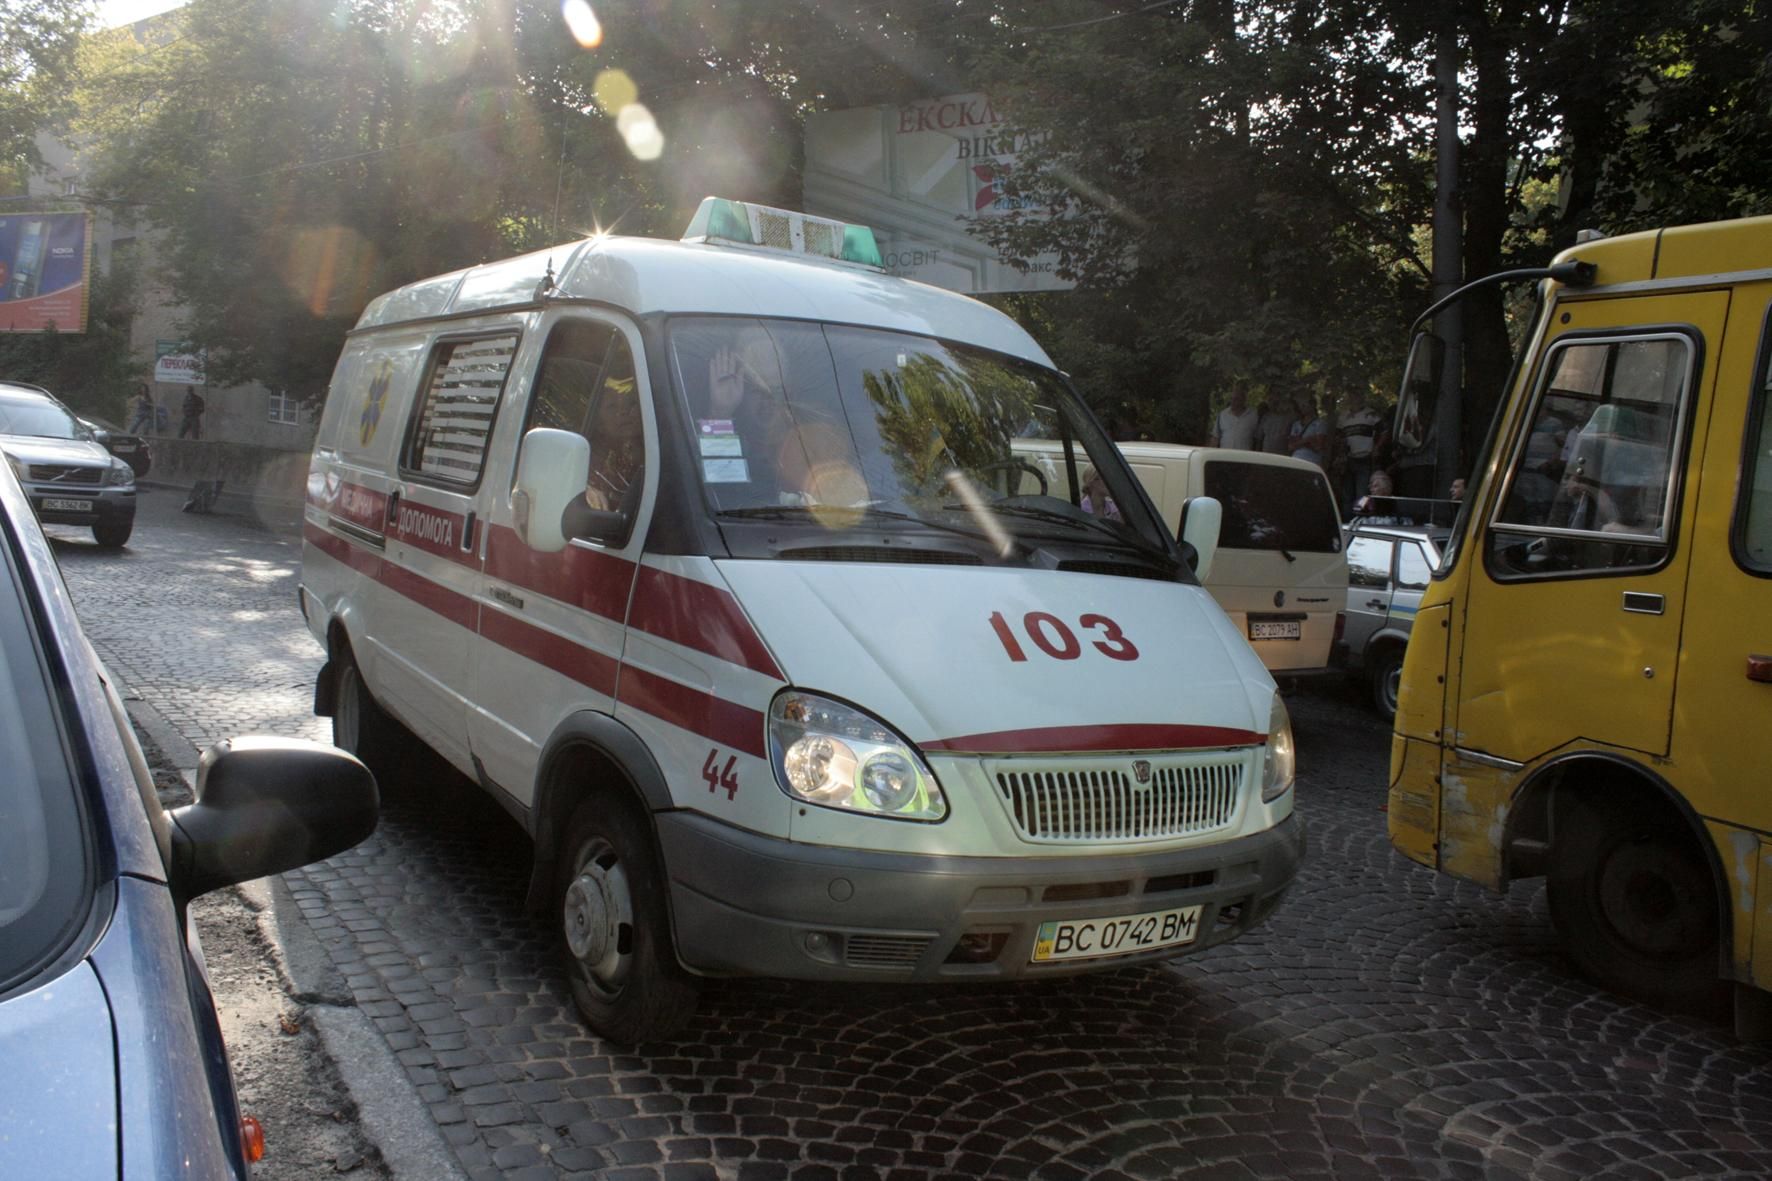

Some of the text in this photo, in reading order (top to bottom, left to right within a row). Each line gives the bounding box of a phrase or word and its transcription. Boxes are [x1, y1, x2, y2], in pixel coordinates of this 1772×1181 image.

[896, 98, 1009, 134] ЕКСКЛ
[881, 250, 940, 267] ОСВІТ
[398, 507, 452, 547] ДОПОМОГА
[988, 611, 1139, 662] 103
[702, 748, 738, 801] 44
[1054, 910, 1195, 954] BC 0742 BM
